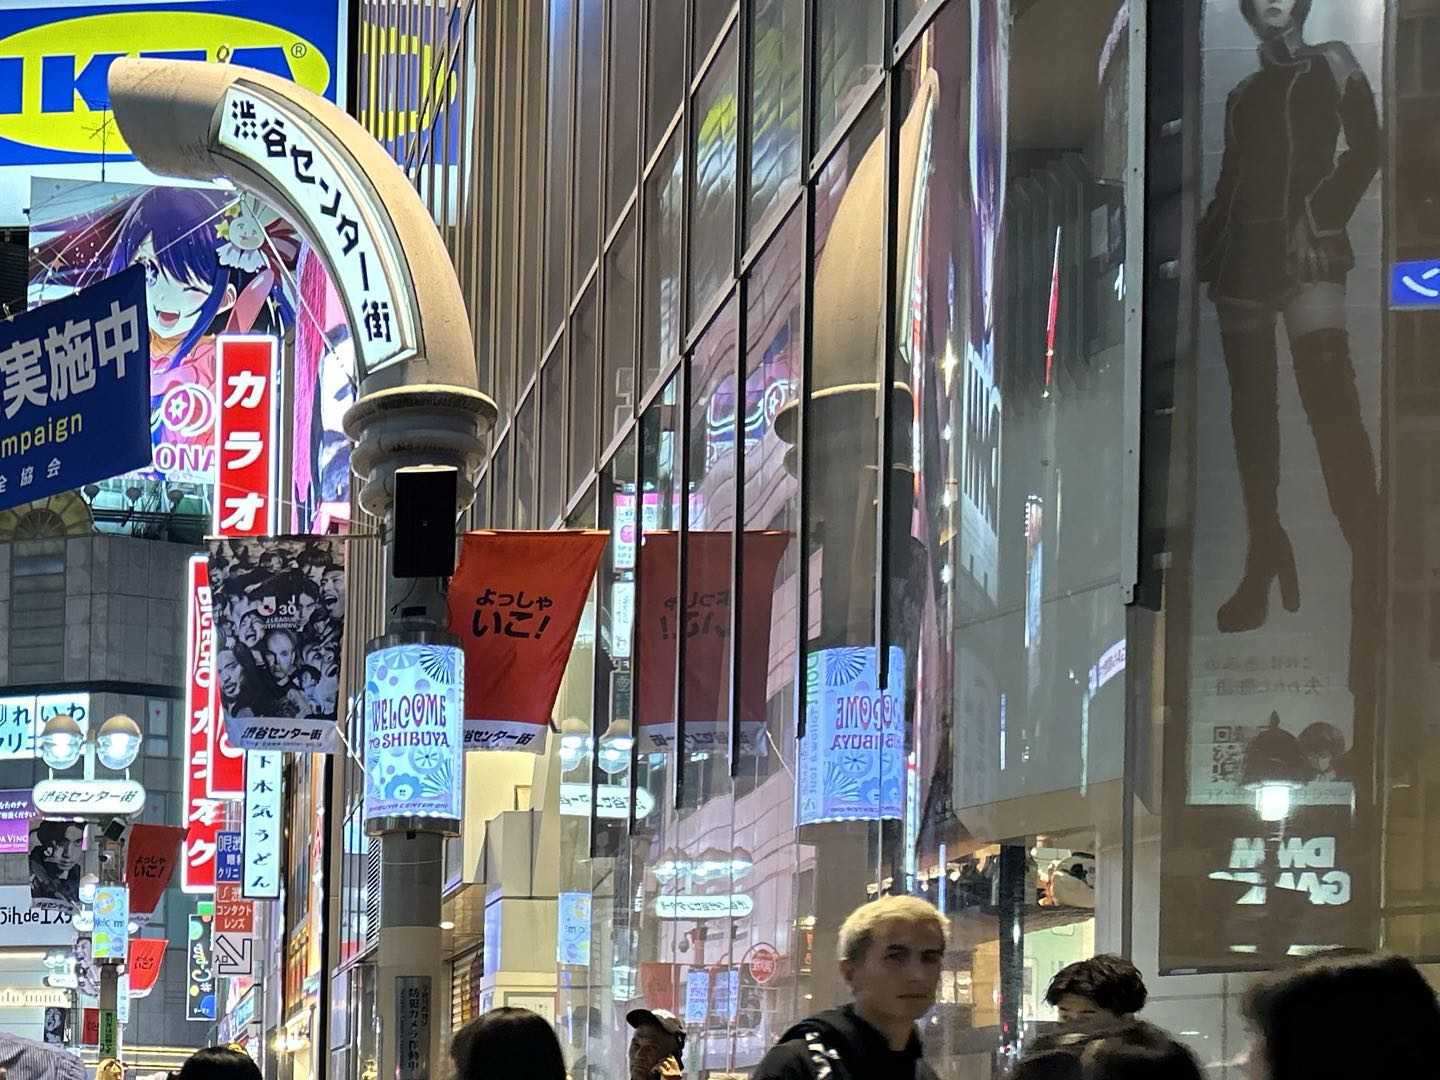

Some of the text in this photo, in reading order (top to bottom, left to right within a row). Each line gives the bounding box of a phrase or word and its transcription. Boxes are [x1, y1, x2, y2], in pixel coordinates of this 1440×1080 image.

[230, 99, 392, 343] 渋谷センター街
[476, 588, 552, 611] よっしゃ
[279, 605, 297, 615] 30
[472, 610, 550, 640] いこ!
[371, 693, 446, 731] WELCOME
[382, 730, 449, 748] SHIBUYA
[216, 905, 252, 916] コンタクト
[224, 918, 245, 929] レンズ
[214, 956, 228, 964] 入口
